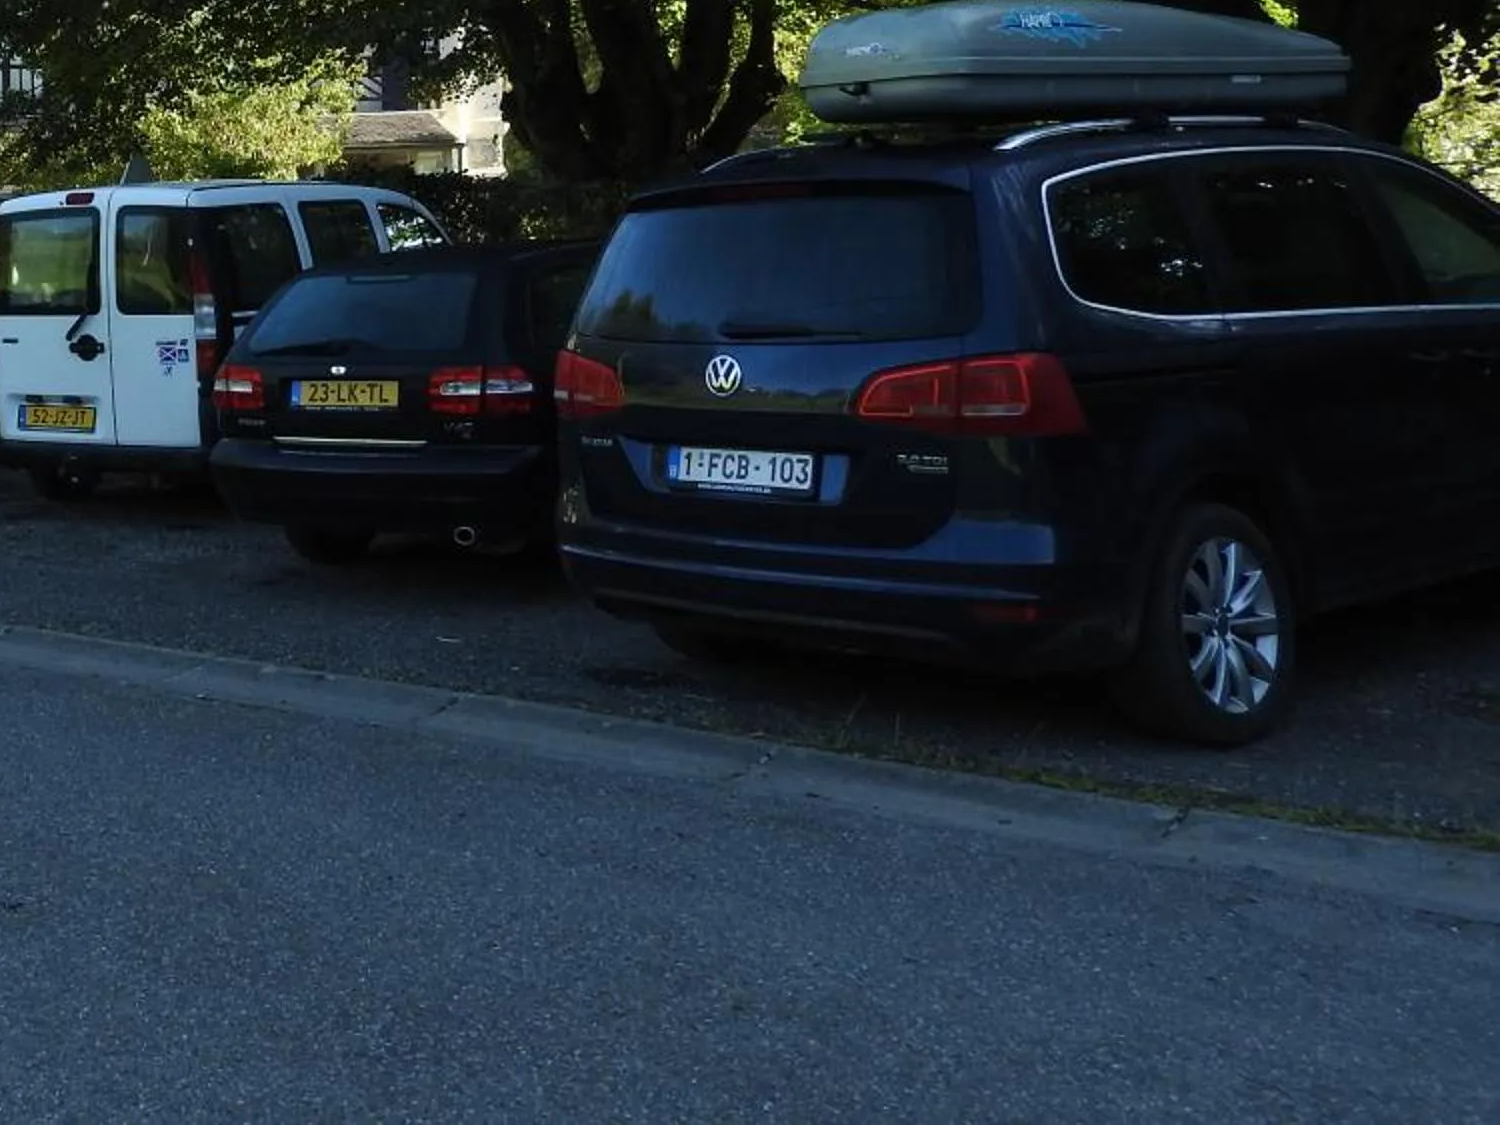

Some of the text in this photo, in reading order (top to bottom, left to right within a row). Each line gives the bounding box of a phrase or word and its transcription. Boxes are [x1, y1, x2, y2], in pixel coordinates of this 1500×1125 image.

[307, 382, 389, 403] 23-LK-TL
[32, 409, 87, 426] 52-JZ-JT
[683, 451, 811, 485] 1-FCB-103
